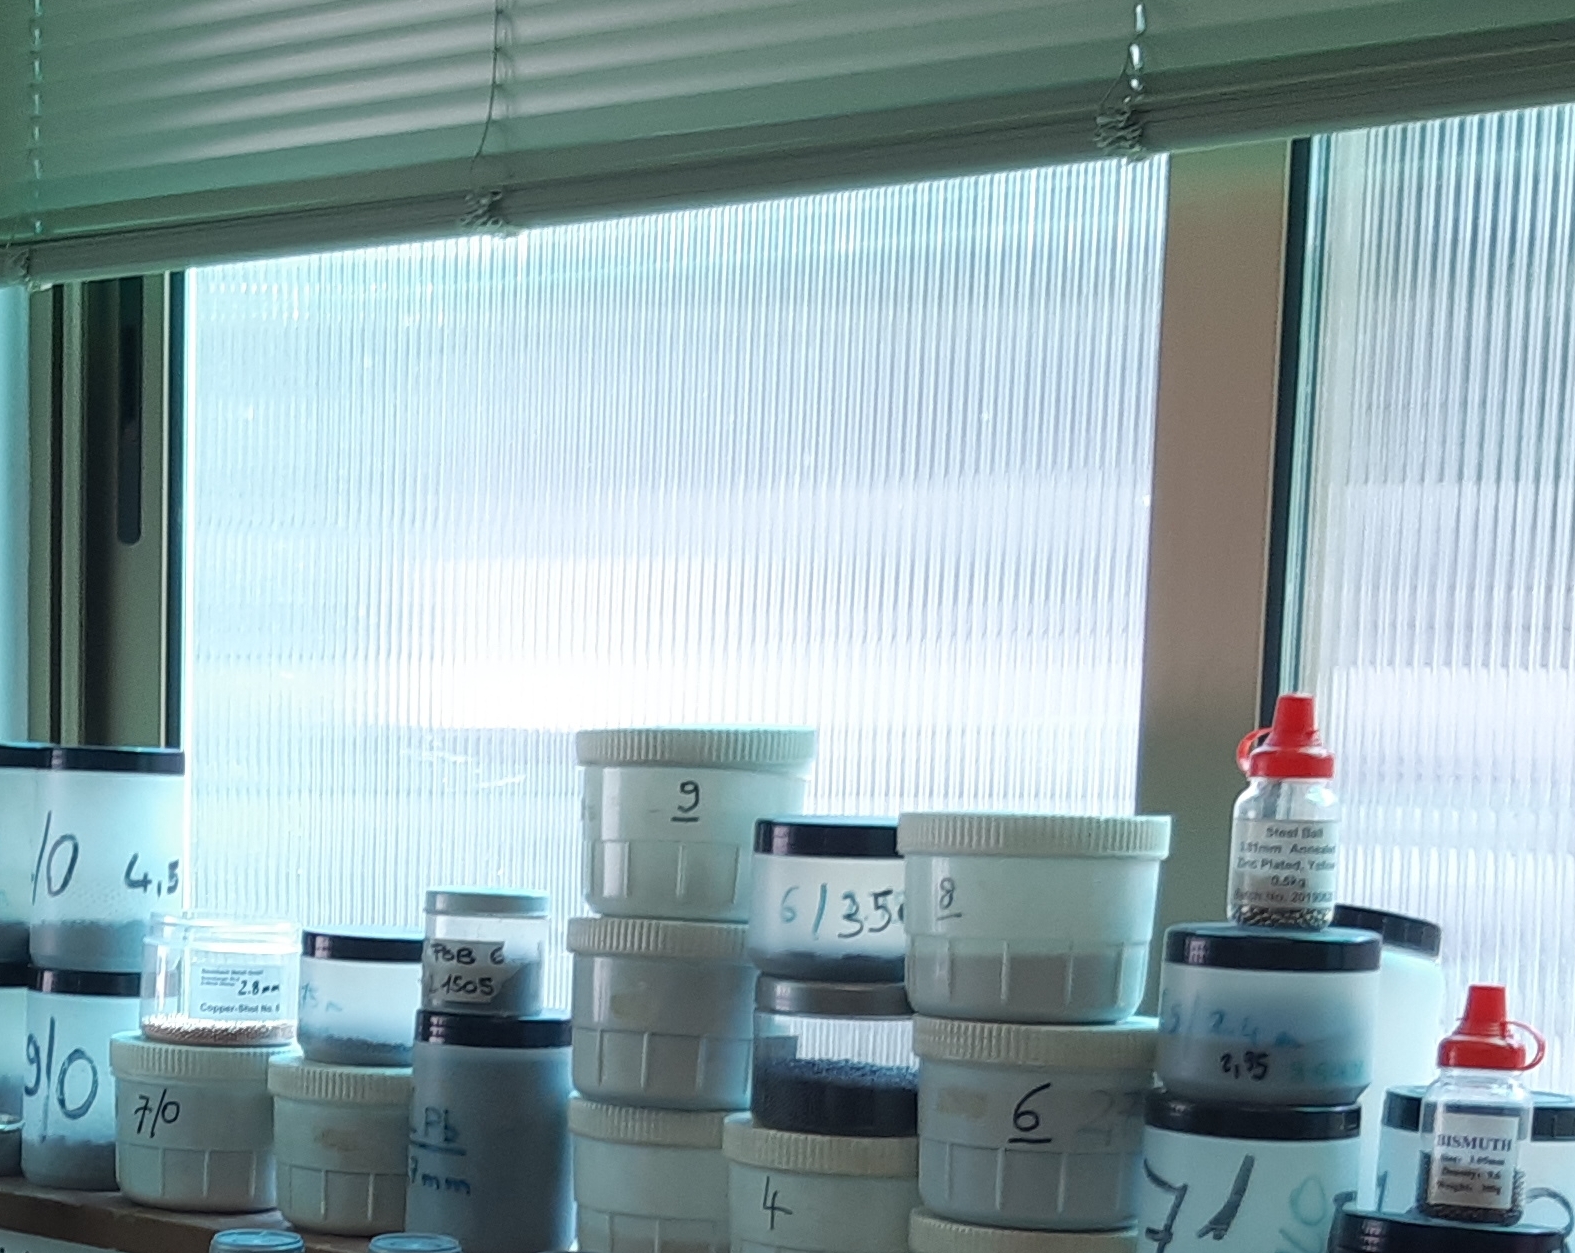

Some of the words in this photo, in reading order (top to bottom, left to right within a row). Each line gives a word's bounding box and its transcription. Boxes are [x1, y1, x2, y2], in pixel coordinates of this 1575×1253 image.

[678, 780, 699, 813] 9
[134, 1089, 180, 1138] 7/0
[1011, 1084, 1050, 1132] 6
[1438, 1134, 1512, 1152] BISMUTH
[762, 1176, 793, 1230] 4
